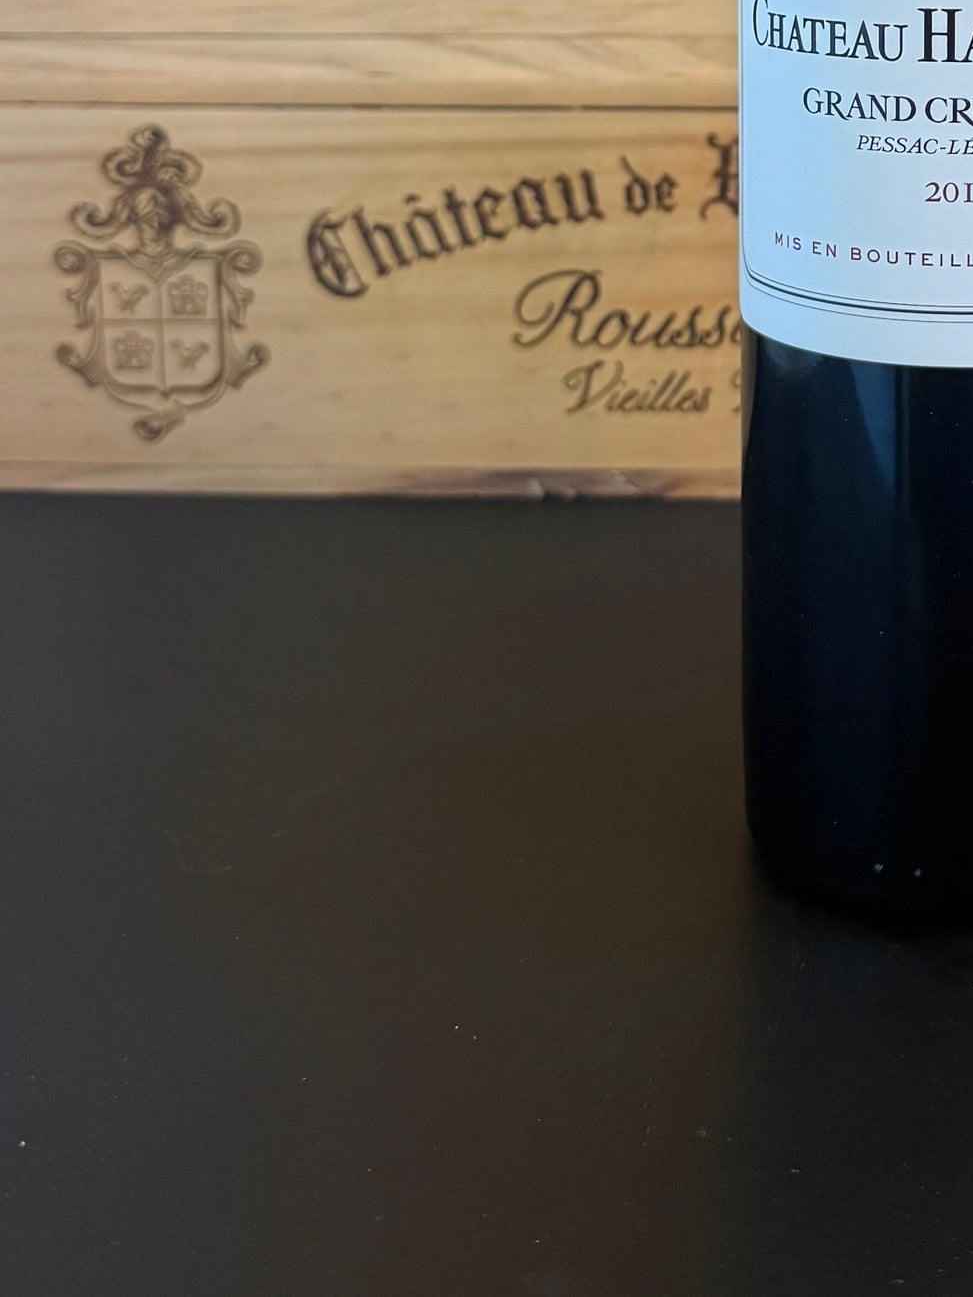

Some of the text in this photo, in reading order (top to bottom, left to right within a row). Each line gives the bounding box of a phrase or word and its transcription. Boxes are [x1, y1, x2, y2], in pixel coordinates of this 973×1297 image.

[802, 87, 916, 122] GRAND
[306, 169, 606, 298] Château
[619, 154, 679, 216] de
[774, 231, 802, 251] MIS
[811, 240, 837, 259] EN
[562, 358, 713, 416] Vieilles
